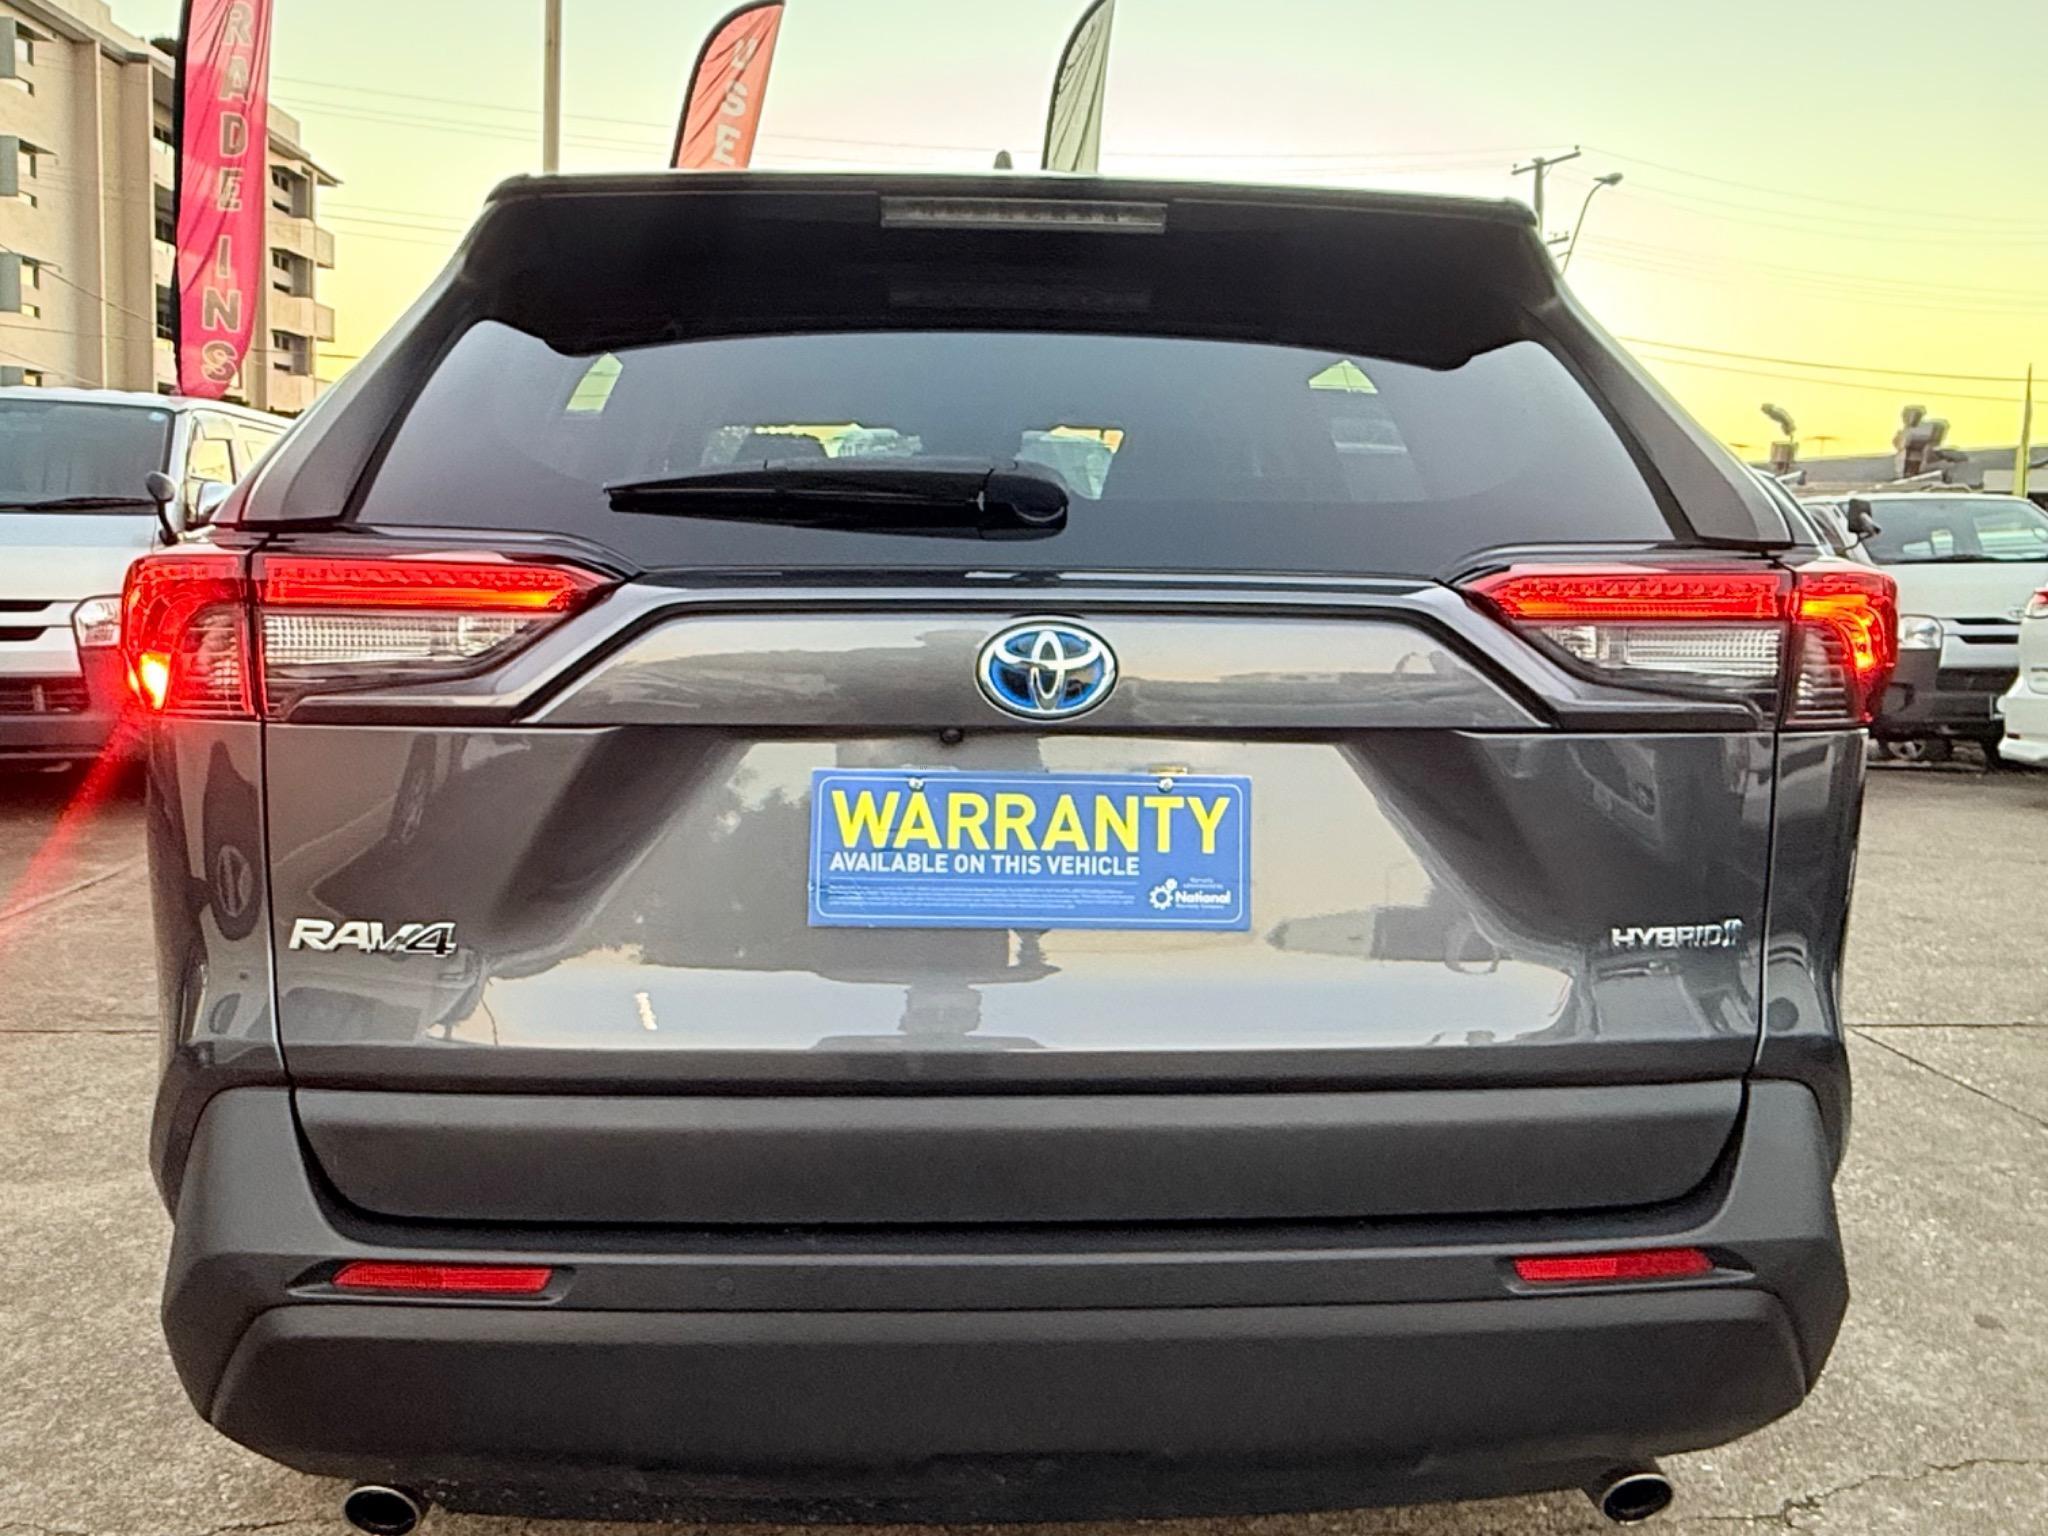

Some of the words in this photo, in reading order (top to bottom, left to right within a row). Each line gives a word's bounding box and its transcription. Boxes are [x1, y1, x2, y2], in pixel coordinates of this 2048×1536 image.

[217, 1, 255, 212] RADE
[712, 36, 760, 167] USE
[201, 234, 242, 383] INS
[831, 788, 1231, 854] WARRANTY
[829, 853, 948, 874] AVAILABLE
[954, 855, 987, 875] ON
[992, 854, 1041, 876] THIS
[1046, 855, 1140, 877] VEHICLE
[1175, 889, 1231, 904] National
[288, 917, 458, 958] RAV4
[1611, 923, 1724, 948] HYBRID
